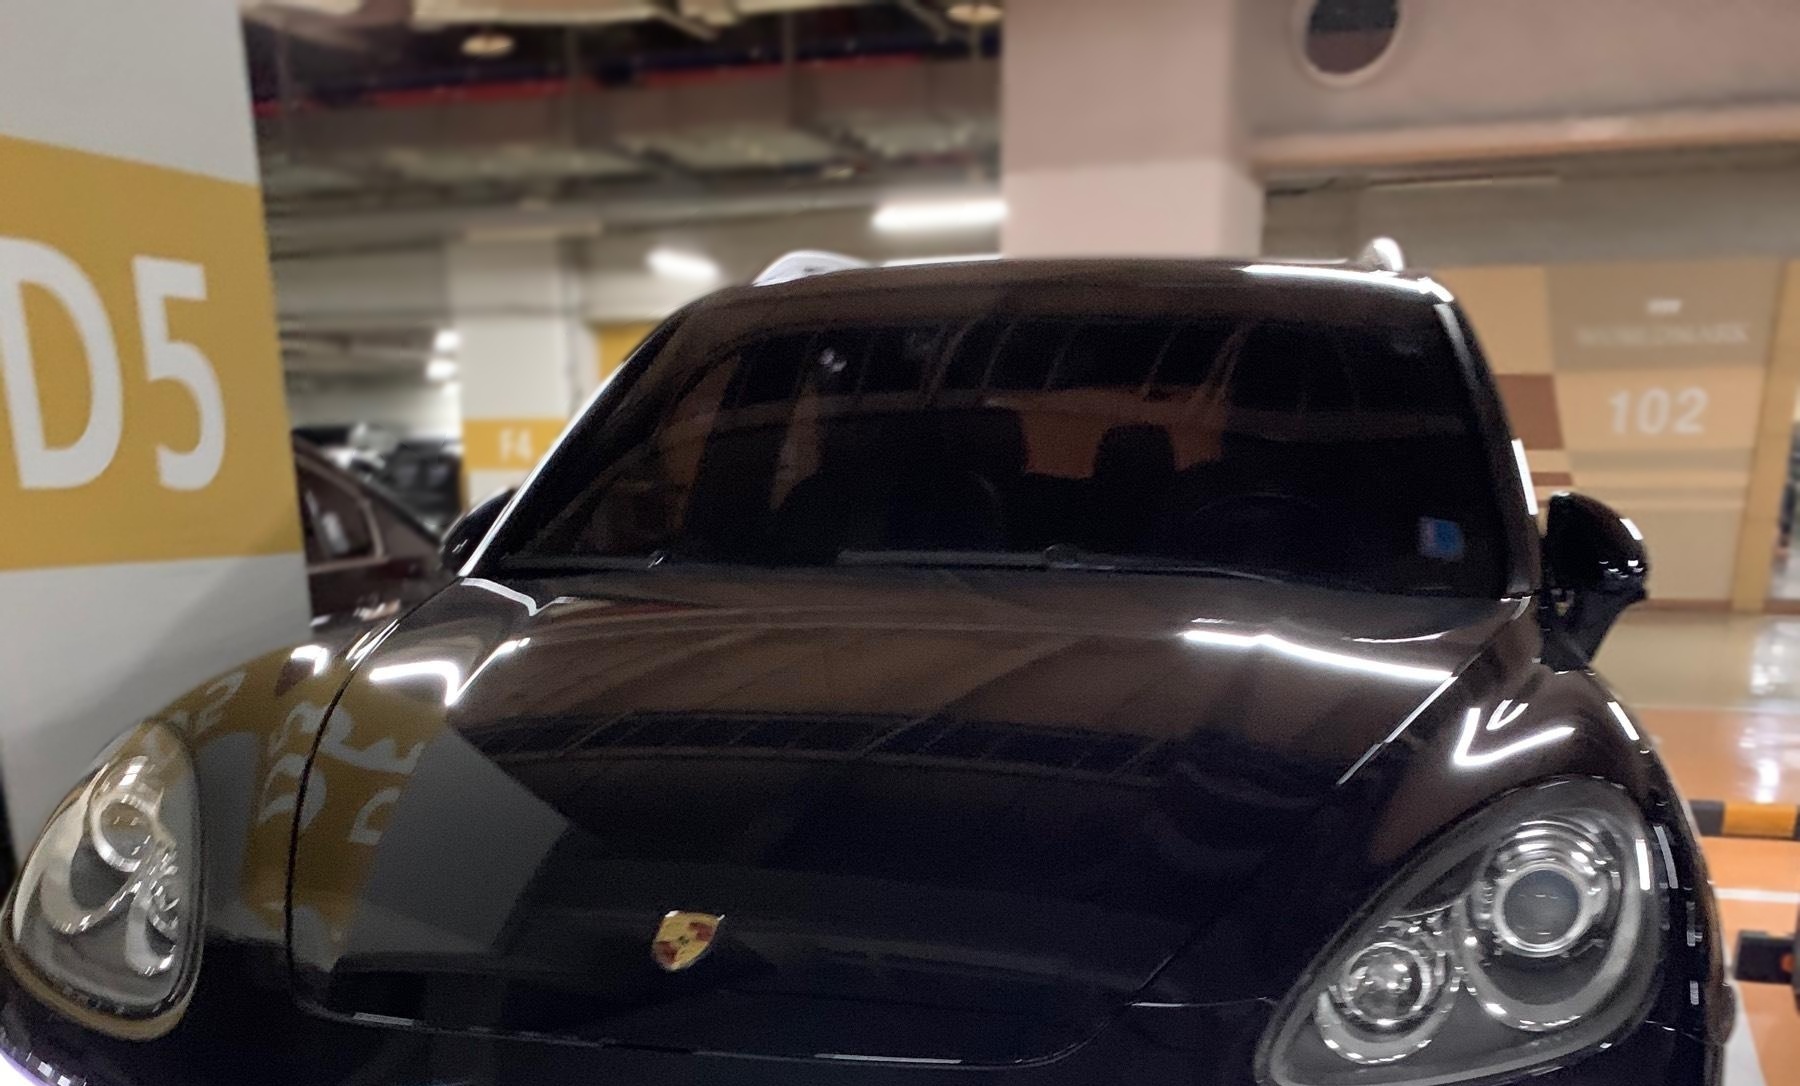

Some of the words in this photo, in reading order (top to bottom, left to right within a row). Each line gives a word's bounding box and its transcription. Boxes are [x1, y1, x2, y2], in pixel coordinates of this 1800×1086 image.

[0, 234, 226, 491] D5
[1608, 386, 1710, 435] 102
[500, 428, 534, 461] F4
